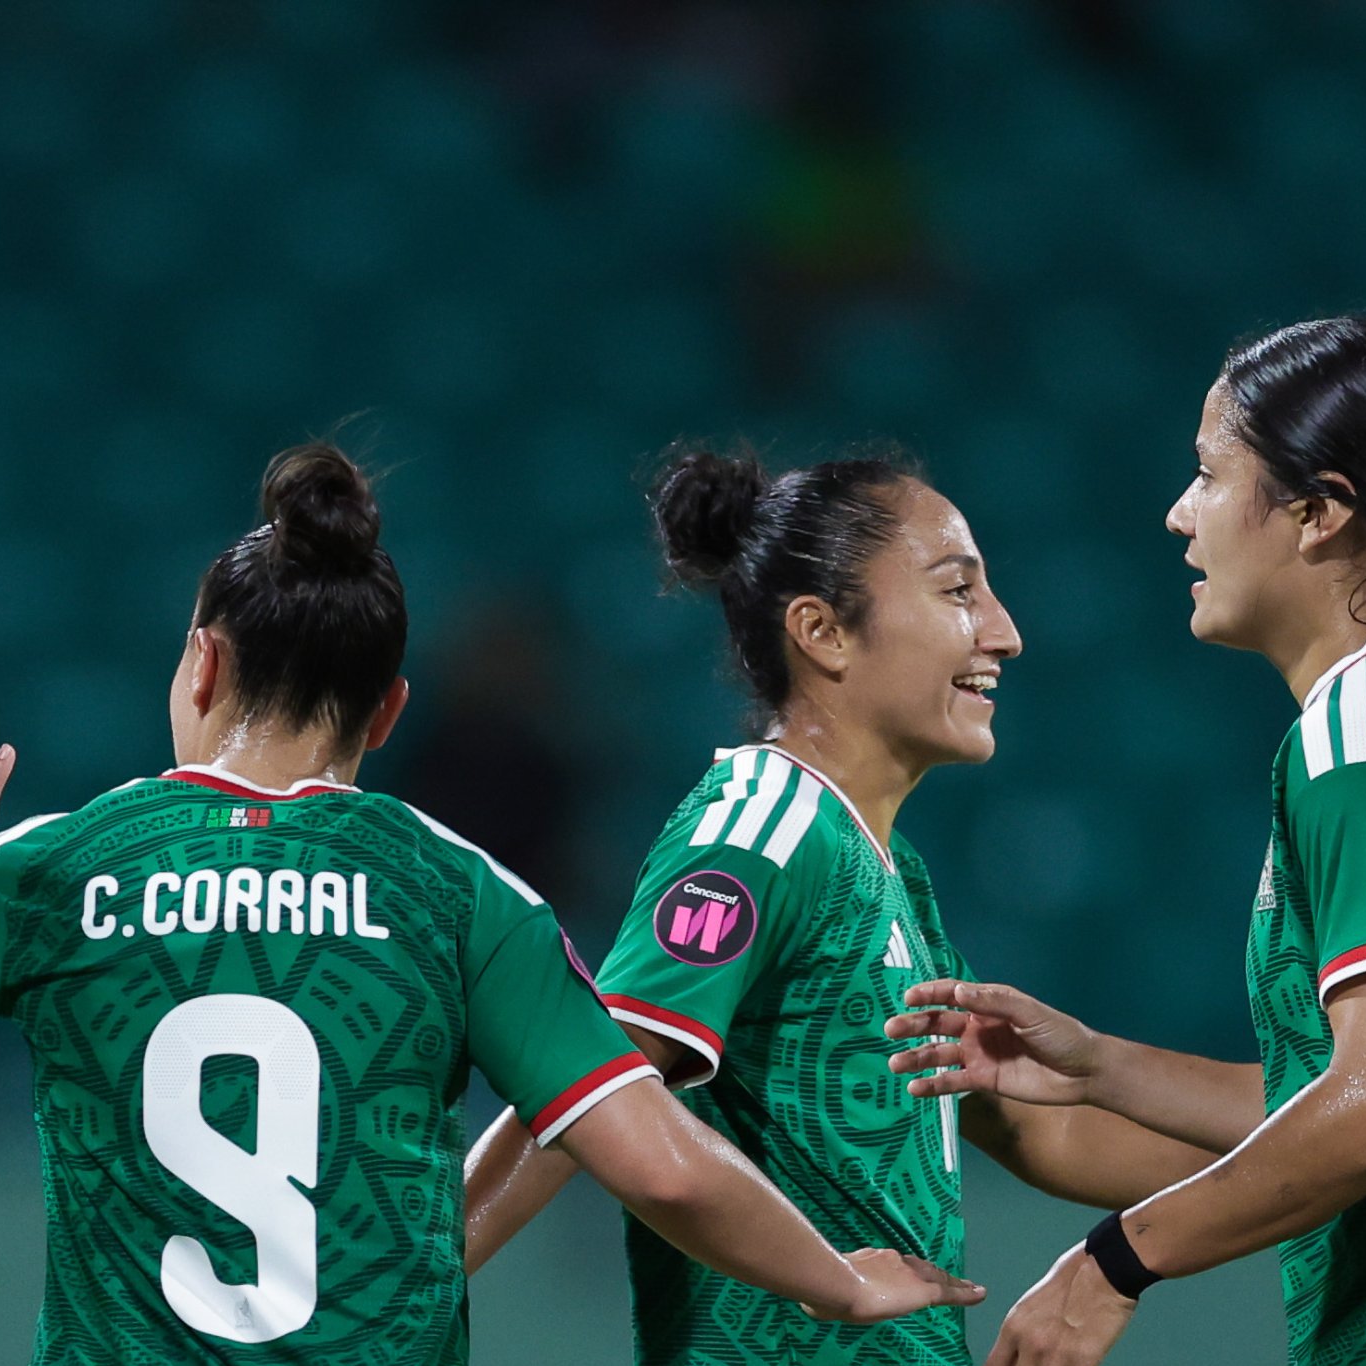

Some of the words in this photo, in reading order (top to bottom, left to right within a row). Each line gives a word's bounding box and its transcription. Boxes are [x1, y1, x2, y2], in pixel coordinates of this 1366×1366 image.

[81, 867, 390, 940] C.CORRAL
[683, 882, 739, 905] Concacaf
[142, 993, 321, 1344] 9
